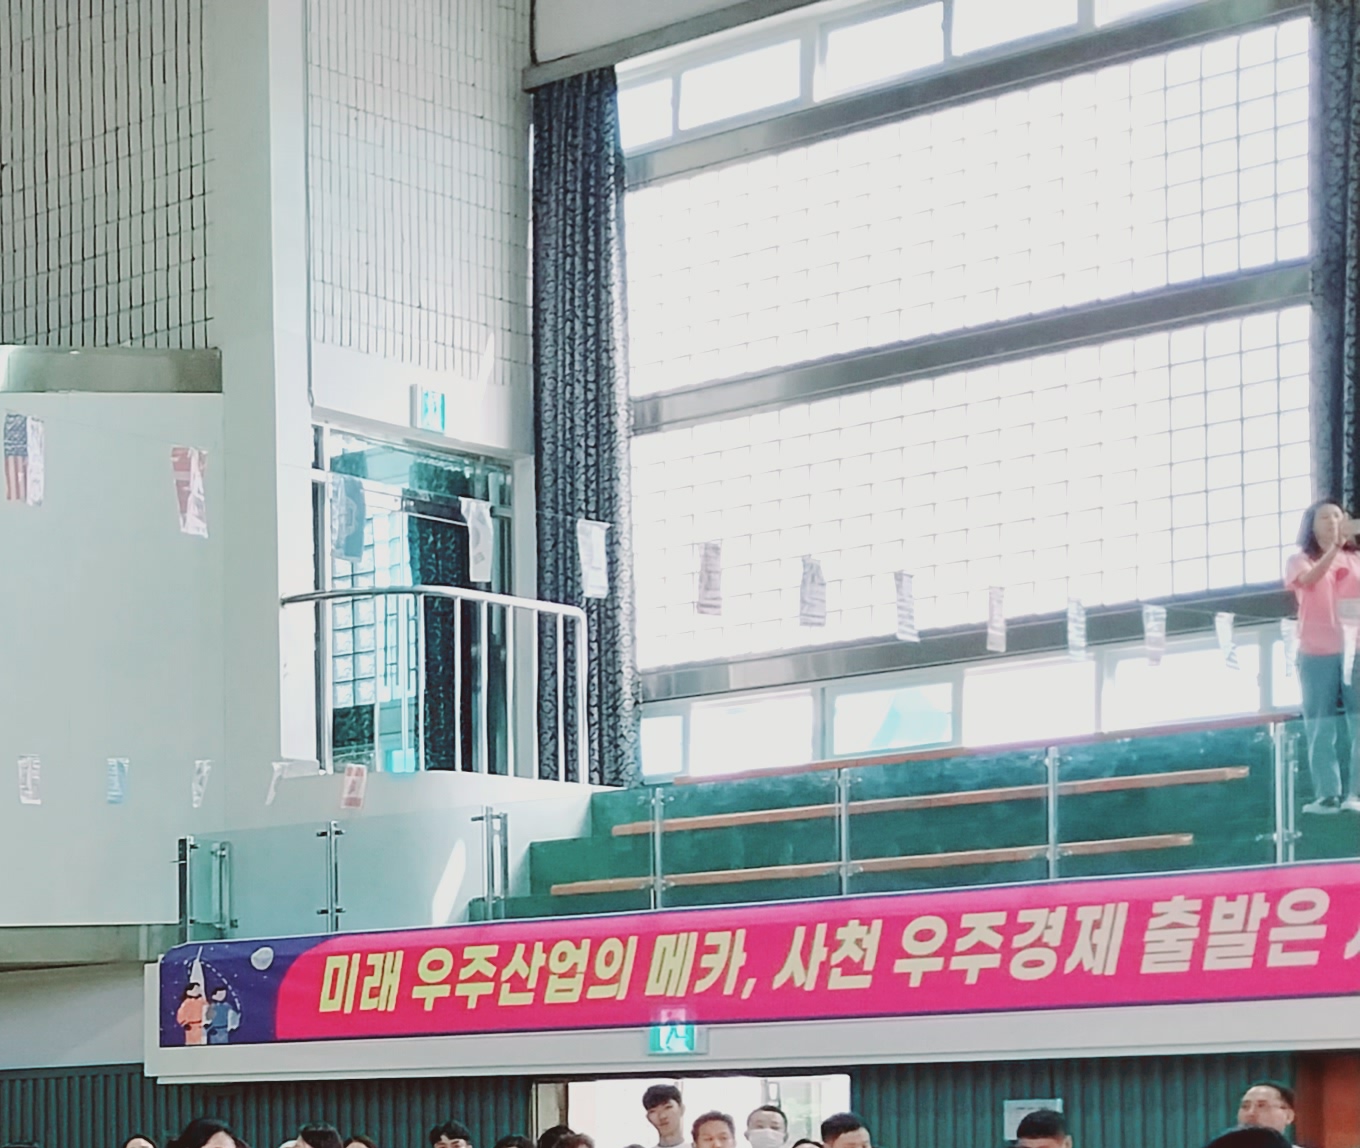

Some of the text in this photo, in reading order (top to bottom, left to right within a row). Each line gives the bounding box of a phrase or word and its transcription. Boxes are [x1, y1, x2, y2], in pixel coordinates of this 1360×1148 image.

[318, 949, 404, 1014] 미래
[411, 935, 639, 1012] 우주산업의
[644, 928, 758, 1000] 메카,
[771, 918, 884, 992] 사천
[892, 902, 1129, 988] 우주경제
[1138, 887, 1332, 975] 출발은
